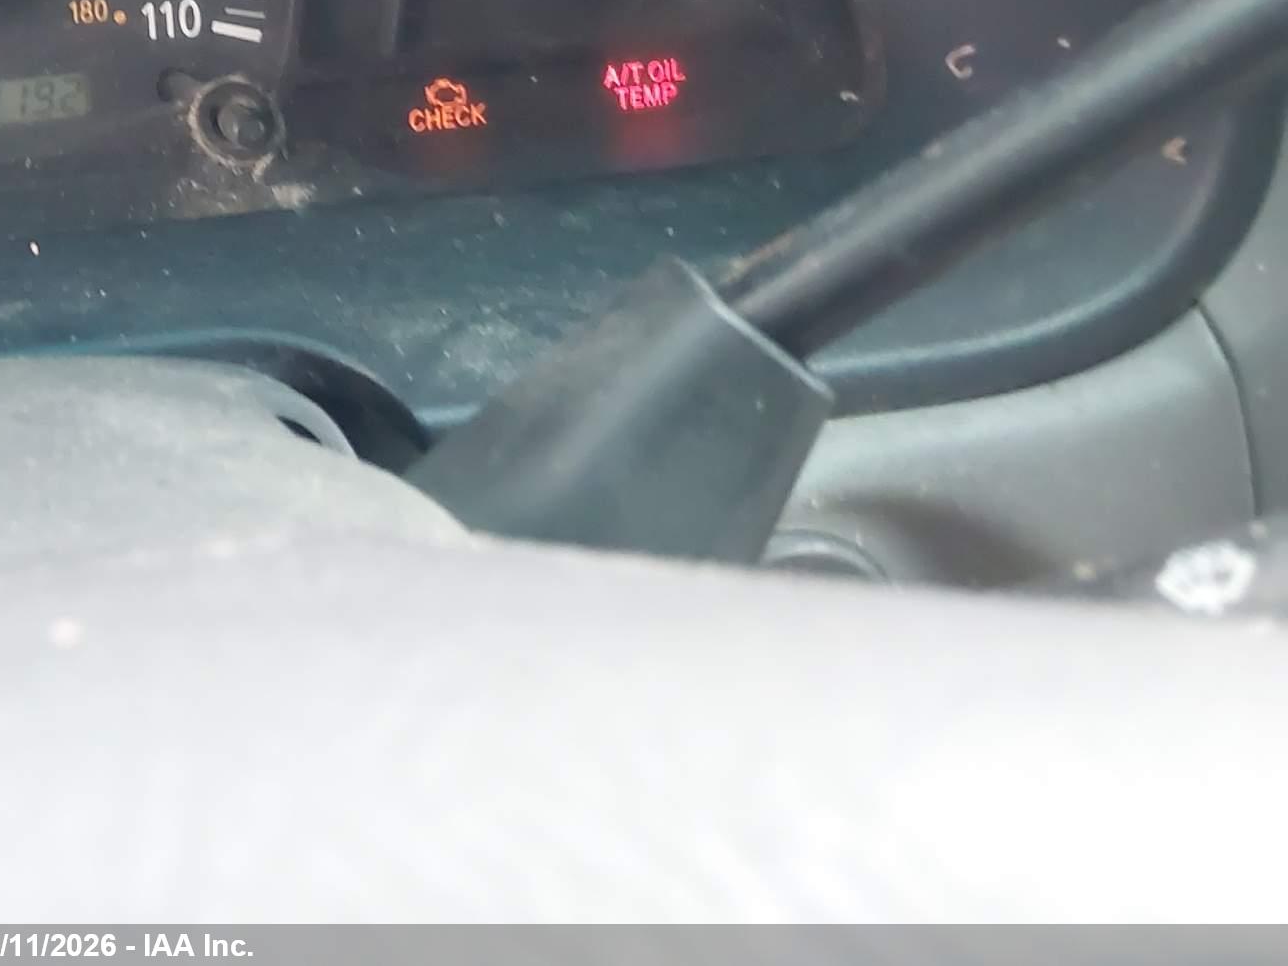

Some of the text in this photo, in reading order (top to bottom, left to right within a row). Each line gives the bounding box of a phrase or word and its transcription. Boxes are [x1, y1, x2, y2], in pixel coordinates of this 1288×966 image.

[603, 57, 686, 89] A/T OIL
[613, 80, 679, 111] TEMP
[408, 102, 488, 133] CHECK
